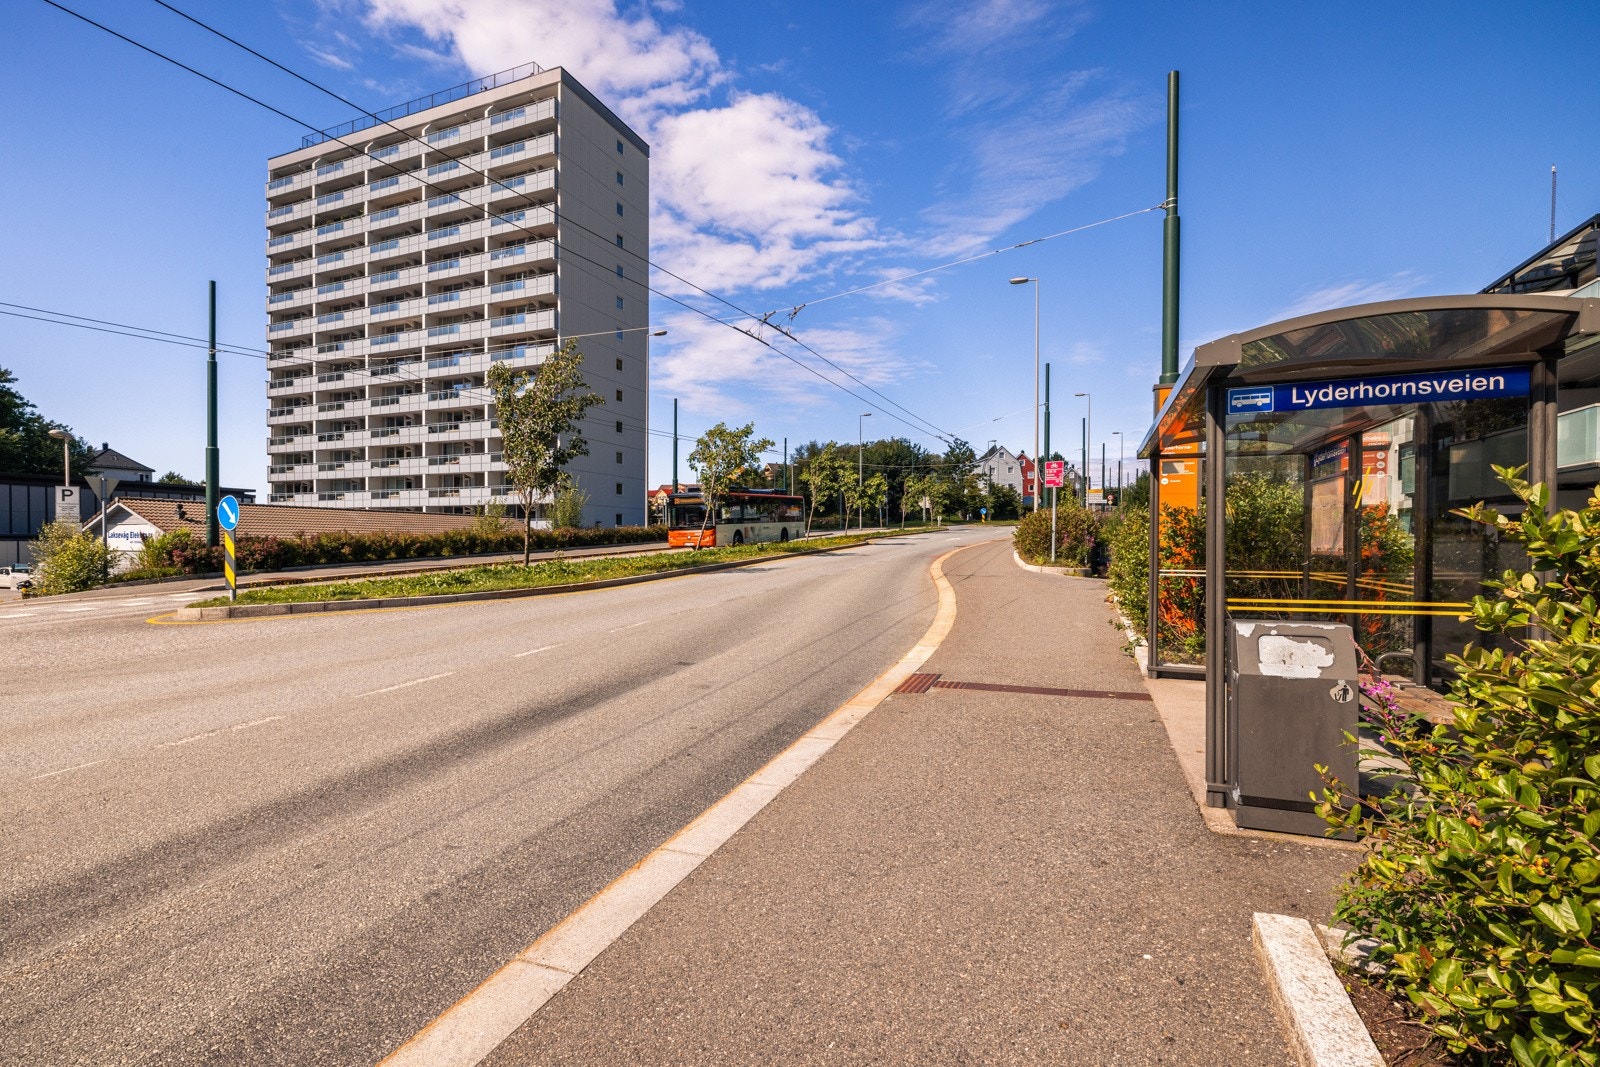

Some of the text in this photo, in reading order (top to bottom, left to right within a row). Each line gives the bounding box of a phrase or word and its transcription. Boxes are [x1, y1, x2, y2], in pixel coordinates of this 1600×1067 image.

[1292, 374, 1504, 407] Lyderhornsveien
[61, 489, 74, 502] P
[107, 531, 129, 540] Laksevåg
